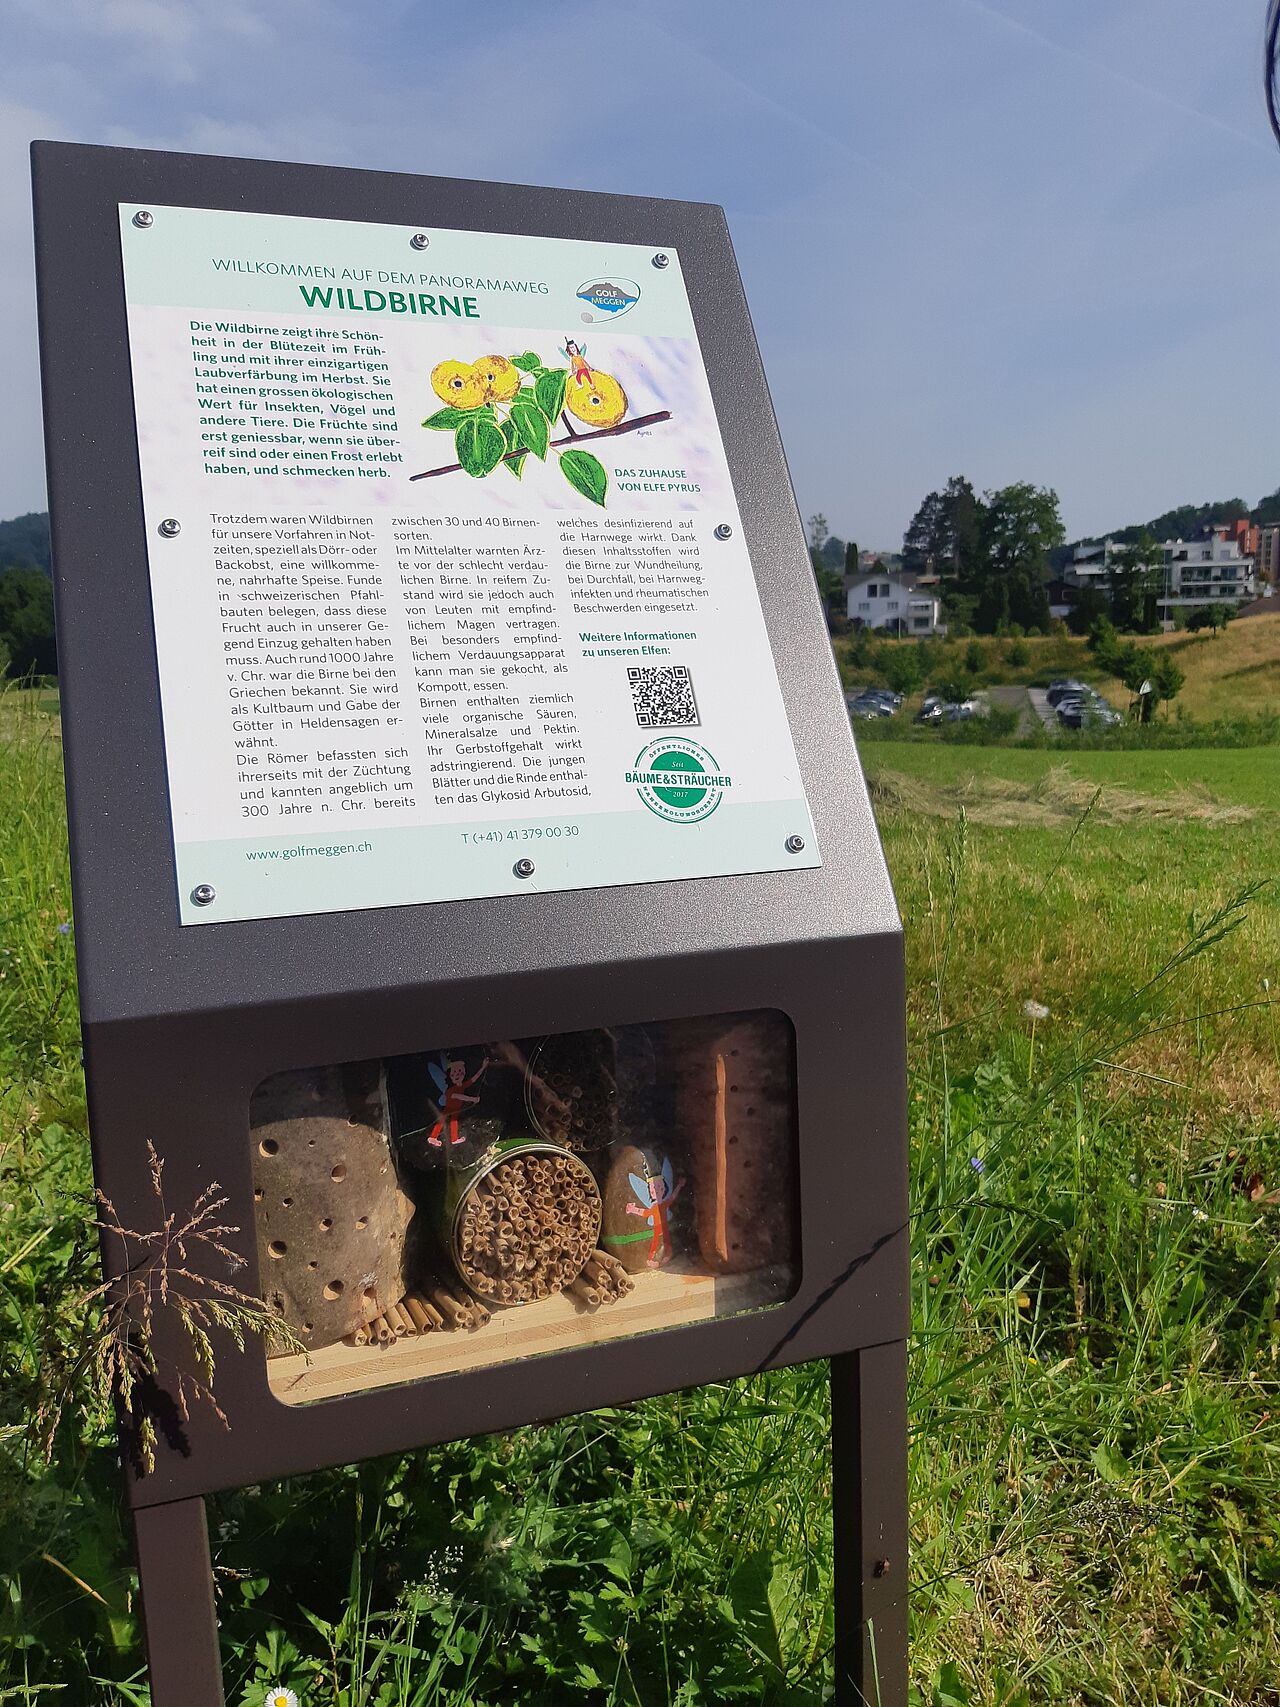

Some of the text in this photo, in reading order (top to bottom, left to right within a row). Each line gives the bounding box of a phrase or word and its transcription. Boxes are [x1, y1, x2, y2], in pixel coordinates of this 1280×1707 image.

[212, 258, 549, 294] WILLKOMMEN AUF DEM PANORAMAWEG
[298, 285, 480, 318] WILDBIRNE
[592, 297, 626, 306] MEGGEN
[190, 320, 384, 342] Die Wildbirne zeigt ihre Schön-
[192, 351, 389, 373] ling und mit ihrer einzigartigen
[194, 366, 391, 386] Laubverfärbung im Herbst. Sie
[197, 398, 396, 416] Wert für Insekten, Vögel und
[201, 431, 400, 447] erst geniessbar, wenn sie über-
[204, 462, 391, 478] haben, und schmecken herb.
[614, 468, 687, 479] DAS ZUHAUSE
[616, 482, 701, 492] VON ELFE PYRUS
[209, 513, 374, 526] Trotzdem waren Wildbirnen
[556, 516, 694, 529] welches desinfizierend auf
[393, 531, 432, 541] sorten.
[395, 544, 546, 556] Im Mittelalter warnten Ärz-
[562, 546, 700, 556] diesen Inhaltsstoffen wird
[215, 559, 380, 571] Backobst, eine willkomme-
[565, 560, 703, 572] die Birne zur Wundheilung,
[216, 574, 382, 587] ne, nahrhafte Speise. Funde
[567, 574, 706, 586] bei Durchfall, bei Harnweg-
[218, 589, 384, 601] in schweizerischen Pfahl-
[570, 588, 709, 599] infekten und rheumatischen
[573, 602, 698, 614] Beschwerden eingesetzt.
[407, 619, 560, 632] lichem Magen vertragen.
[223, 636, 392, 652] gend Einzug gehalten haben
[410, 632, 562, 646] Bei besonders empfind-
[578, 630, 697, 642] Weitere Informationen
[412, 648, 566, 662] lichem Verdauungsapparat
[582, 645, 671, 658] zu unseren Elfen:
[229, 682, 399, 699] Griechen bekannt. Sie wird
[417, 681, 509, 694] Kompott, essen.
[419, 692, 574, 708] Birnen enthalten ziemlich
[232, 716, 403, 732] Götter in Heldensagen er-
[422, 708, 577, 724] viele organische Säuren,
[425, 723, 580, 741] Mineralsalze und Pektin.
[234, 736, 278, 750] wähnt.
[427, 738, 583, 756] Ihr Gerbstoffgehalt wirkt
[430, 755, 586, 773] adstringierend. Die jungen
[238, 764, 412, 783] ihrerseits mit der Züchtung
[625, 770, 732, 786] BÄUME&STRÄUCHER
[240, 780, 414, 800] und kannten angeblich um
[434, 784, 592, 805] ten das Glykosid Arbutosid,
[241, 796, 416, 818] 300 Jahre n. Chr. bereits
[460, 825, 579, 844] T (+41) 41 379 00 30
[246, 840, 372, 860] www.golfmeggen.ch
